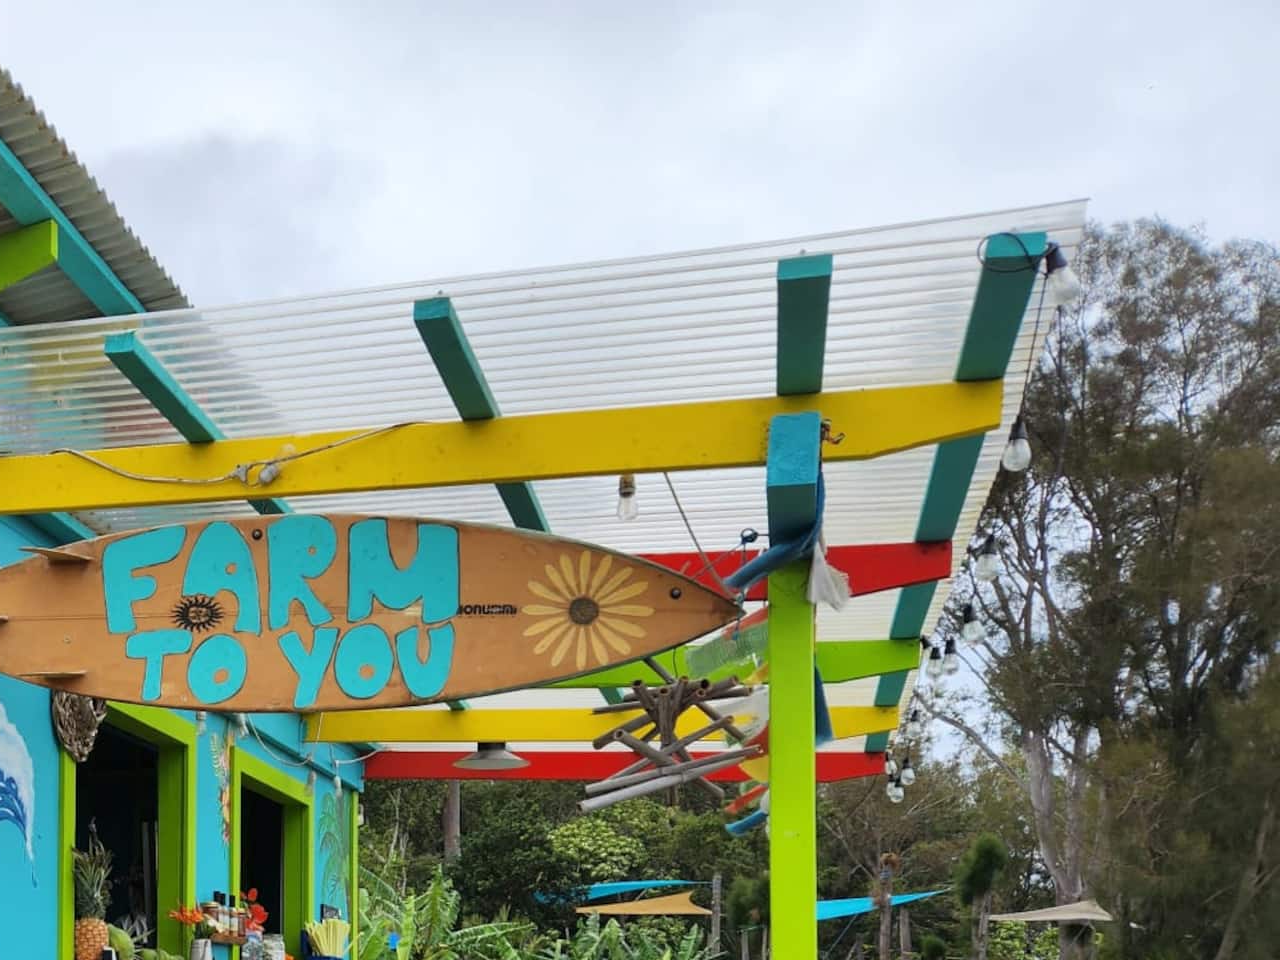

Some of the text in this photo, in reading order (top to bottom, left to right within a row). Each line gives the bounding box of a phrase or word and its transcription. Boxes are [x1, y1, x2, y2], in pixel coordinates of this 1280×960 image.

[102, 514, 460, 636] FARM
[125, 621, 455, 709] TO YOU
